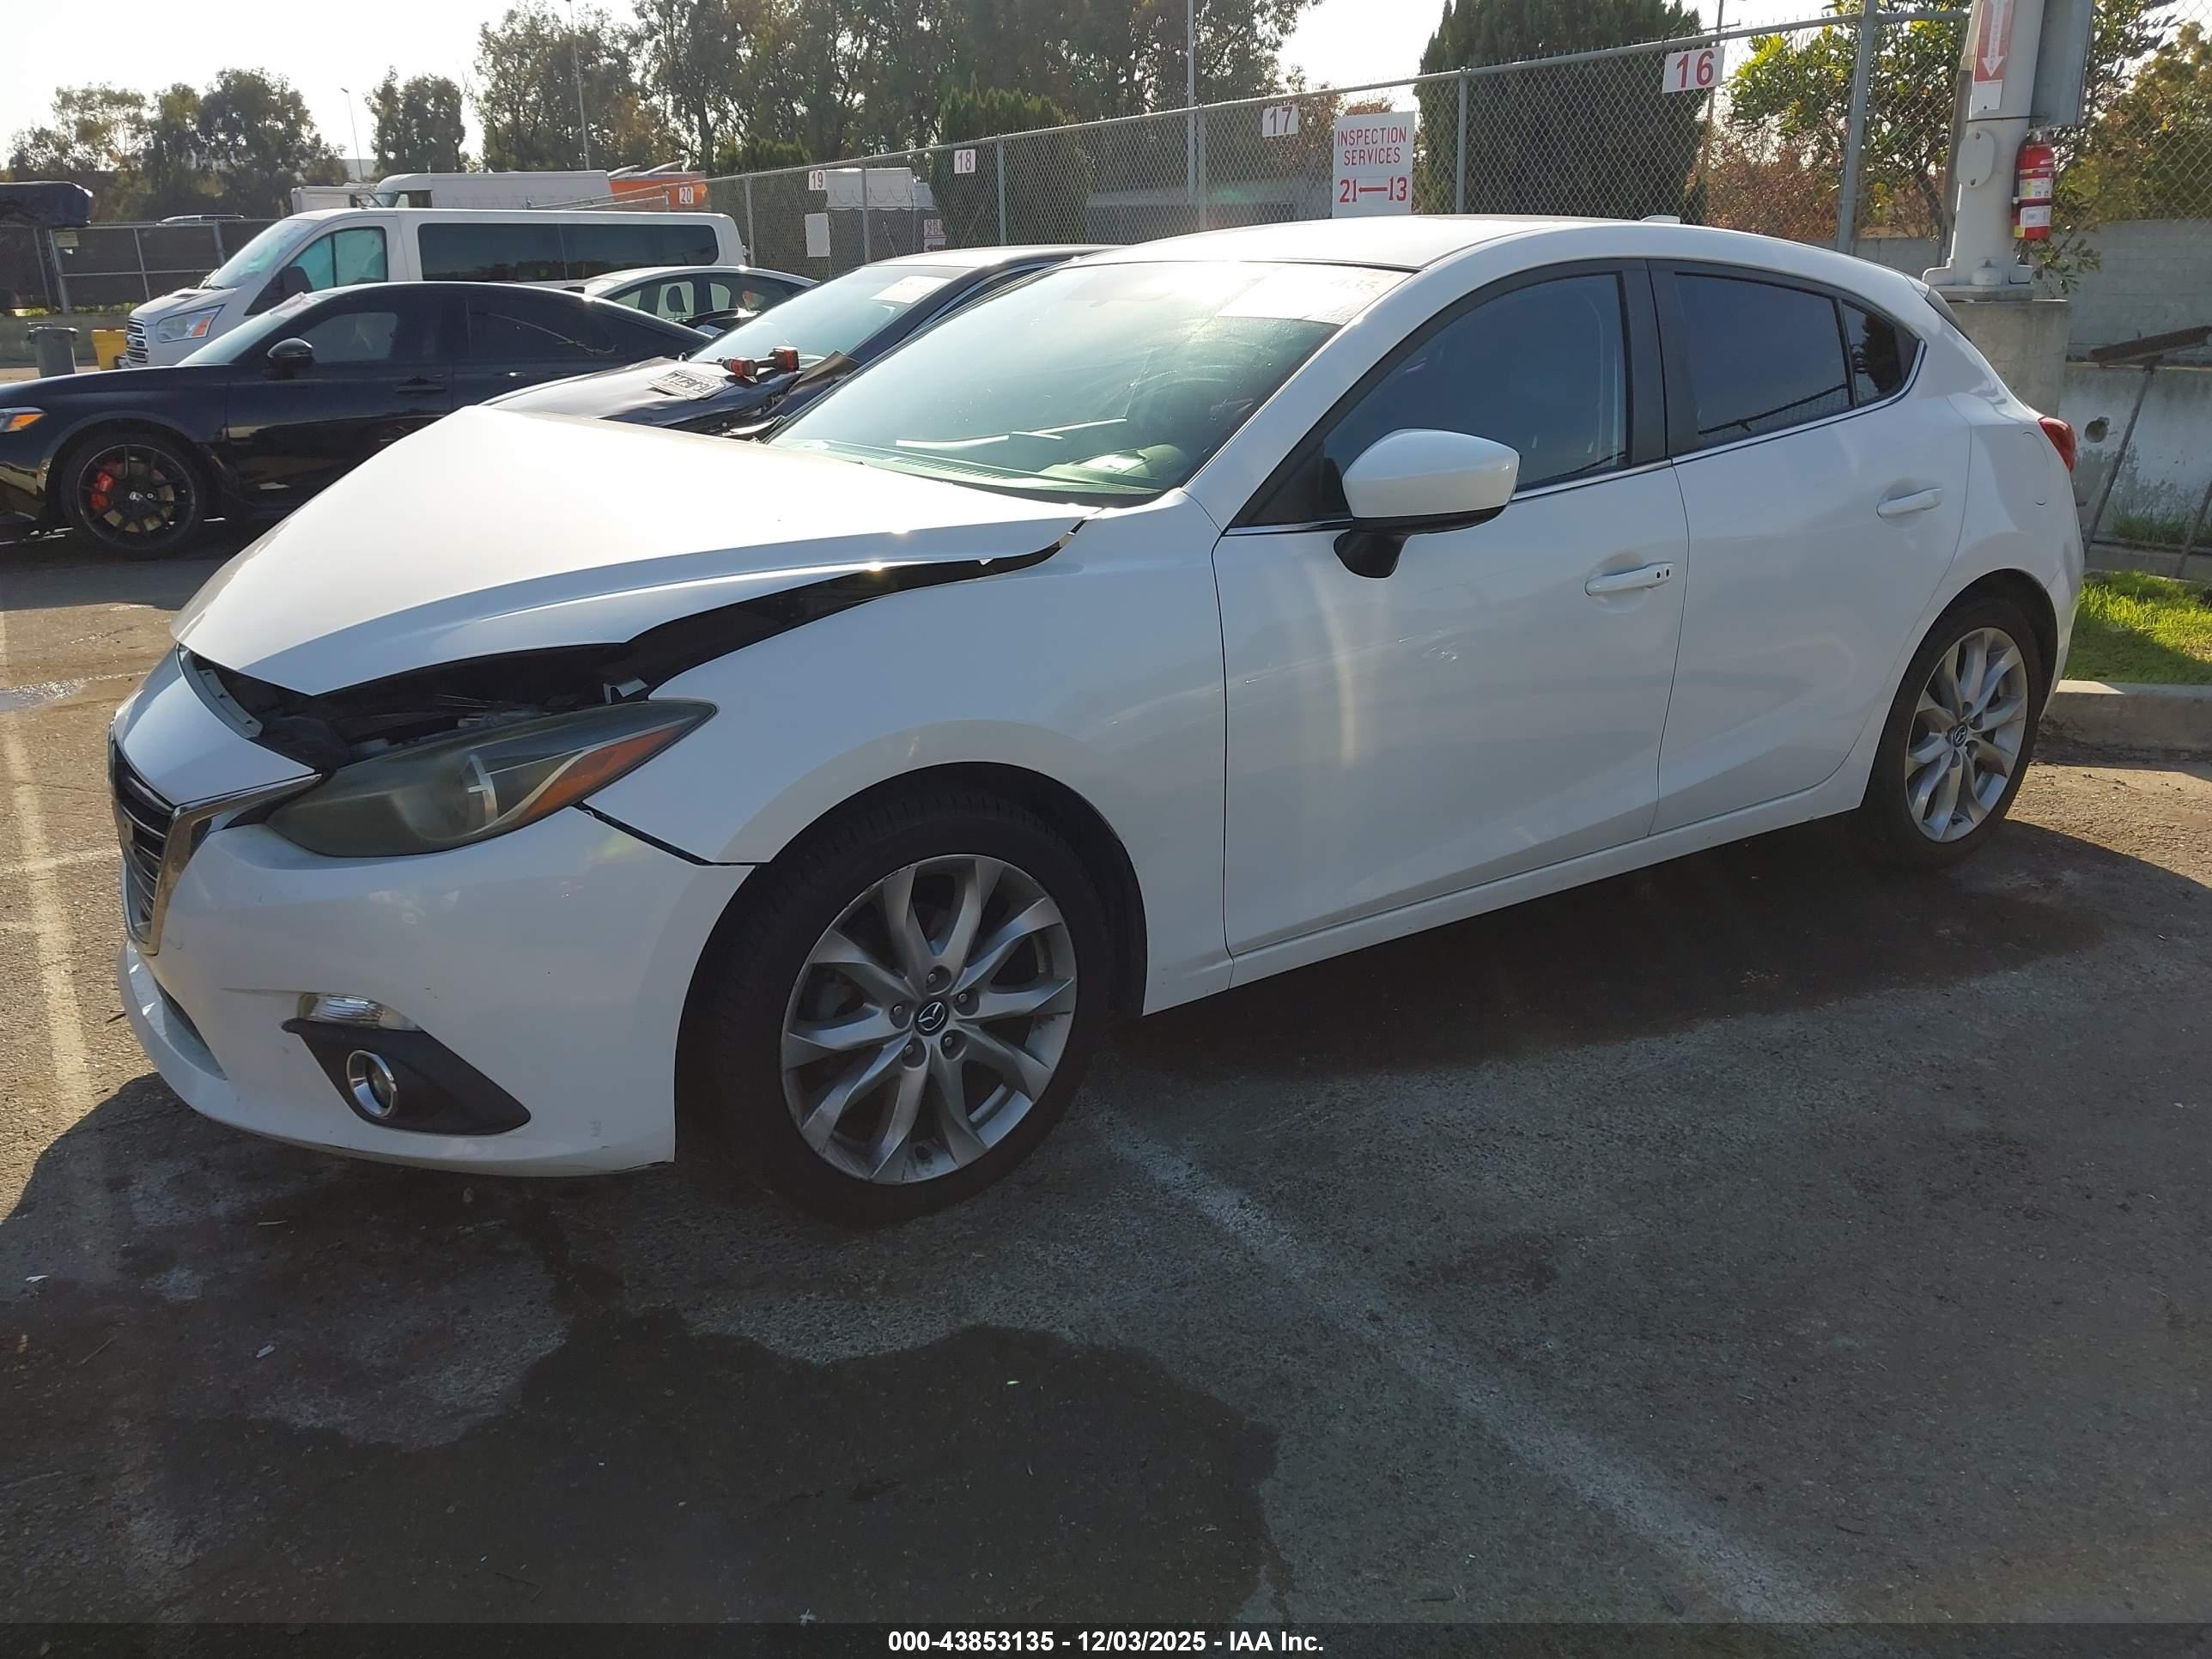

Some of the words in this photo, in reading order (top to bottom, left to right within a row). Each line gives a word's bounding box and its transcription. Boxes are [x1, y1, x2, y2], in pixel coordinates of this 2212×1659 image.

[1677, 50, 1715, 88] 16
[1269, 106, 1293, 135] 17
[1337, 125, 1407, 147] INSPECTION
[957, 150, 971, 173] 18
[1344, 147, 1401, 167] SERVICES
[811, 171, 823, 189] 19
[1339, 178, 1358, 203] 21
[1389, 176, 1407, 202] 13
[681, 187, 692, 203] 20
